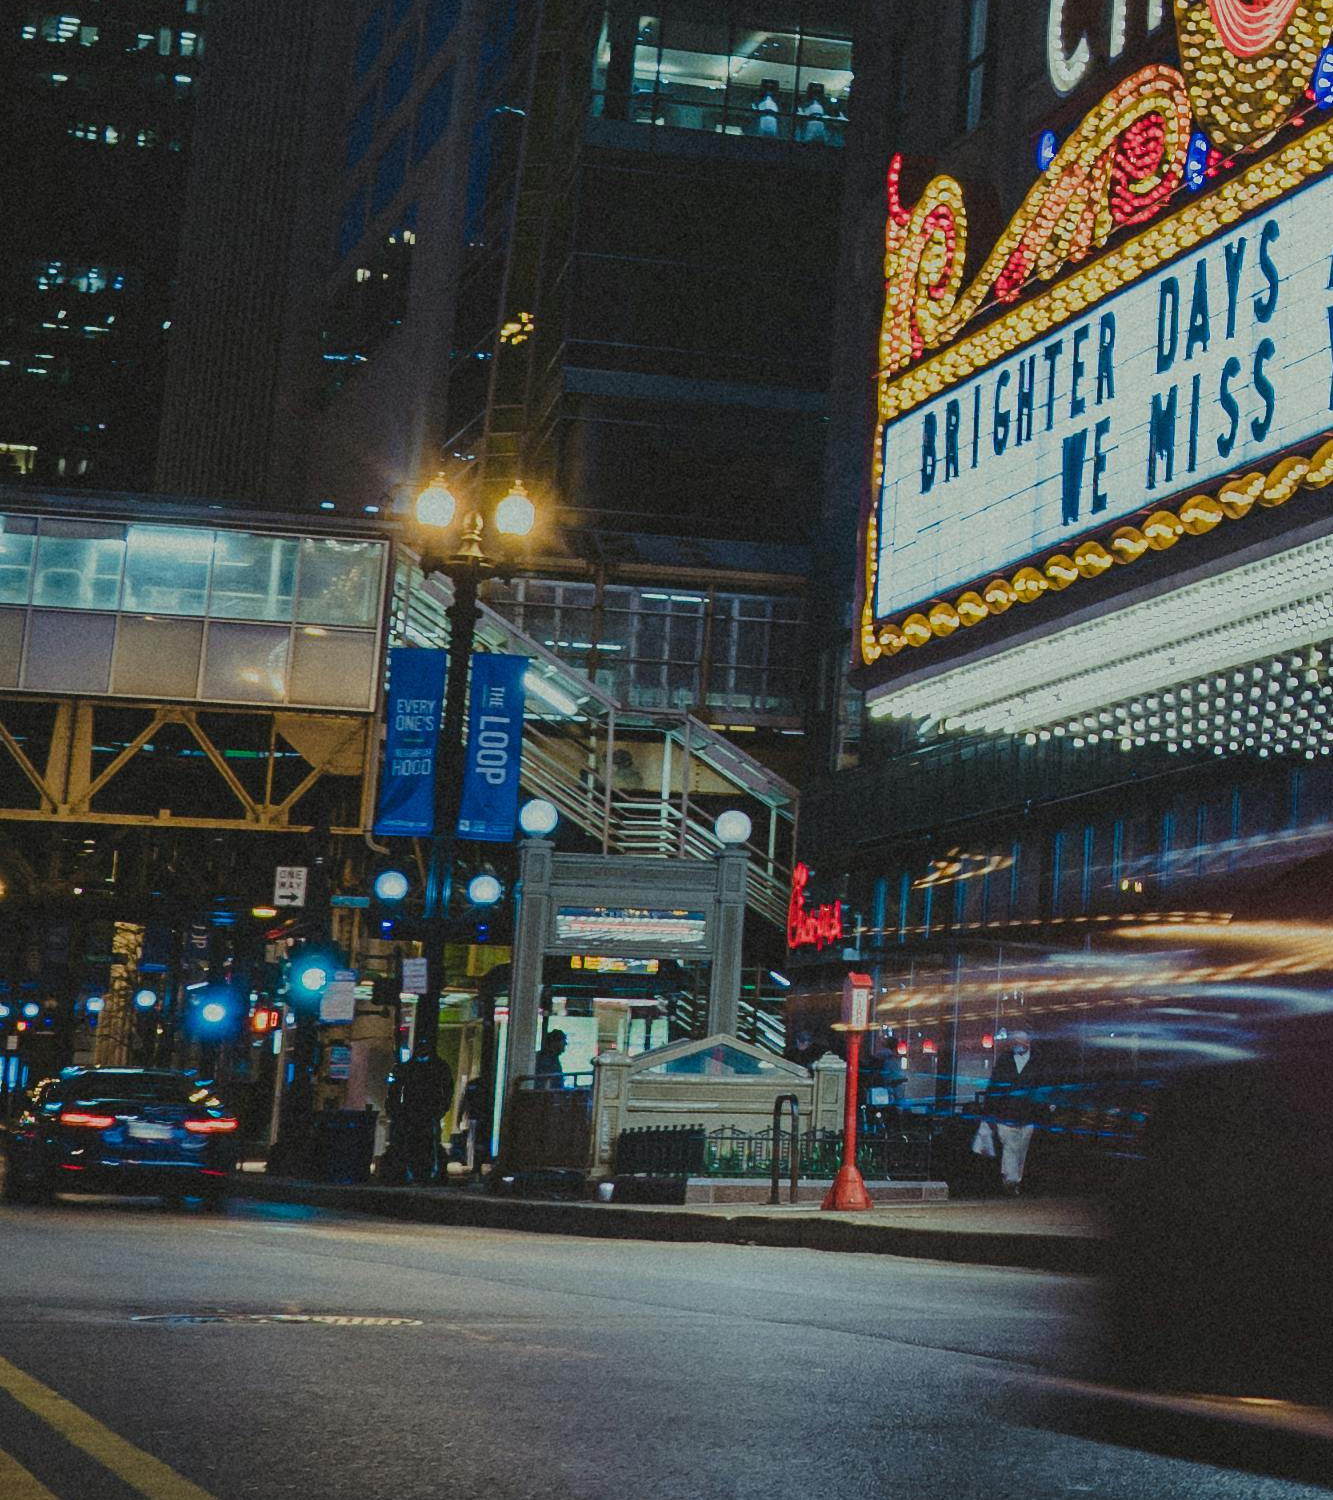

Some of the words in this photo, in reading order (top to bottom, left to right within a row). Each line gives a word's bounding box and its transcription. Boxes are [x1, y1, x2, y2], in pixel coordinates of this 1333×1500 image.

[920, 311, 1118, 494] BRIGHTER
[1157, 221, 1280, 374] DAYS
[1061, 418, 1108, 525] WE
[1148, 338, 1275, 489] MISS
[396, 698, 436, 714] EVERY
[489, 686, 506, 709] THE
[395, 715, 435, 732] ONE'S
[475, 715, 511, 785] LOOP
[391, 758, 432, 776] HOOD
[280, 870, 302, 879] ONE
